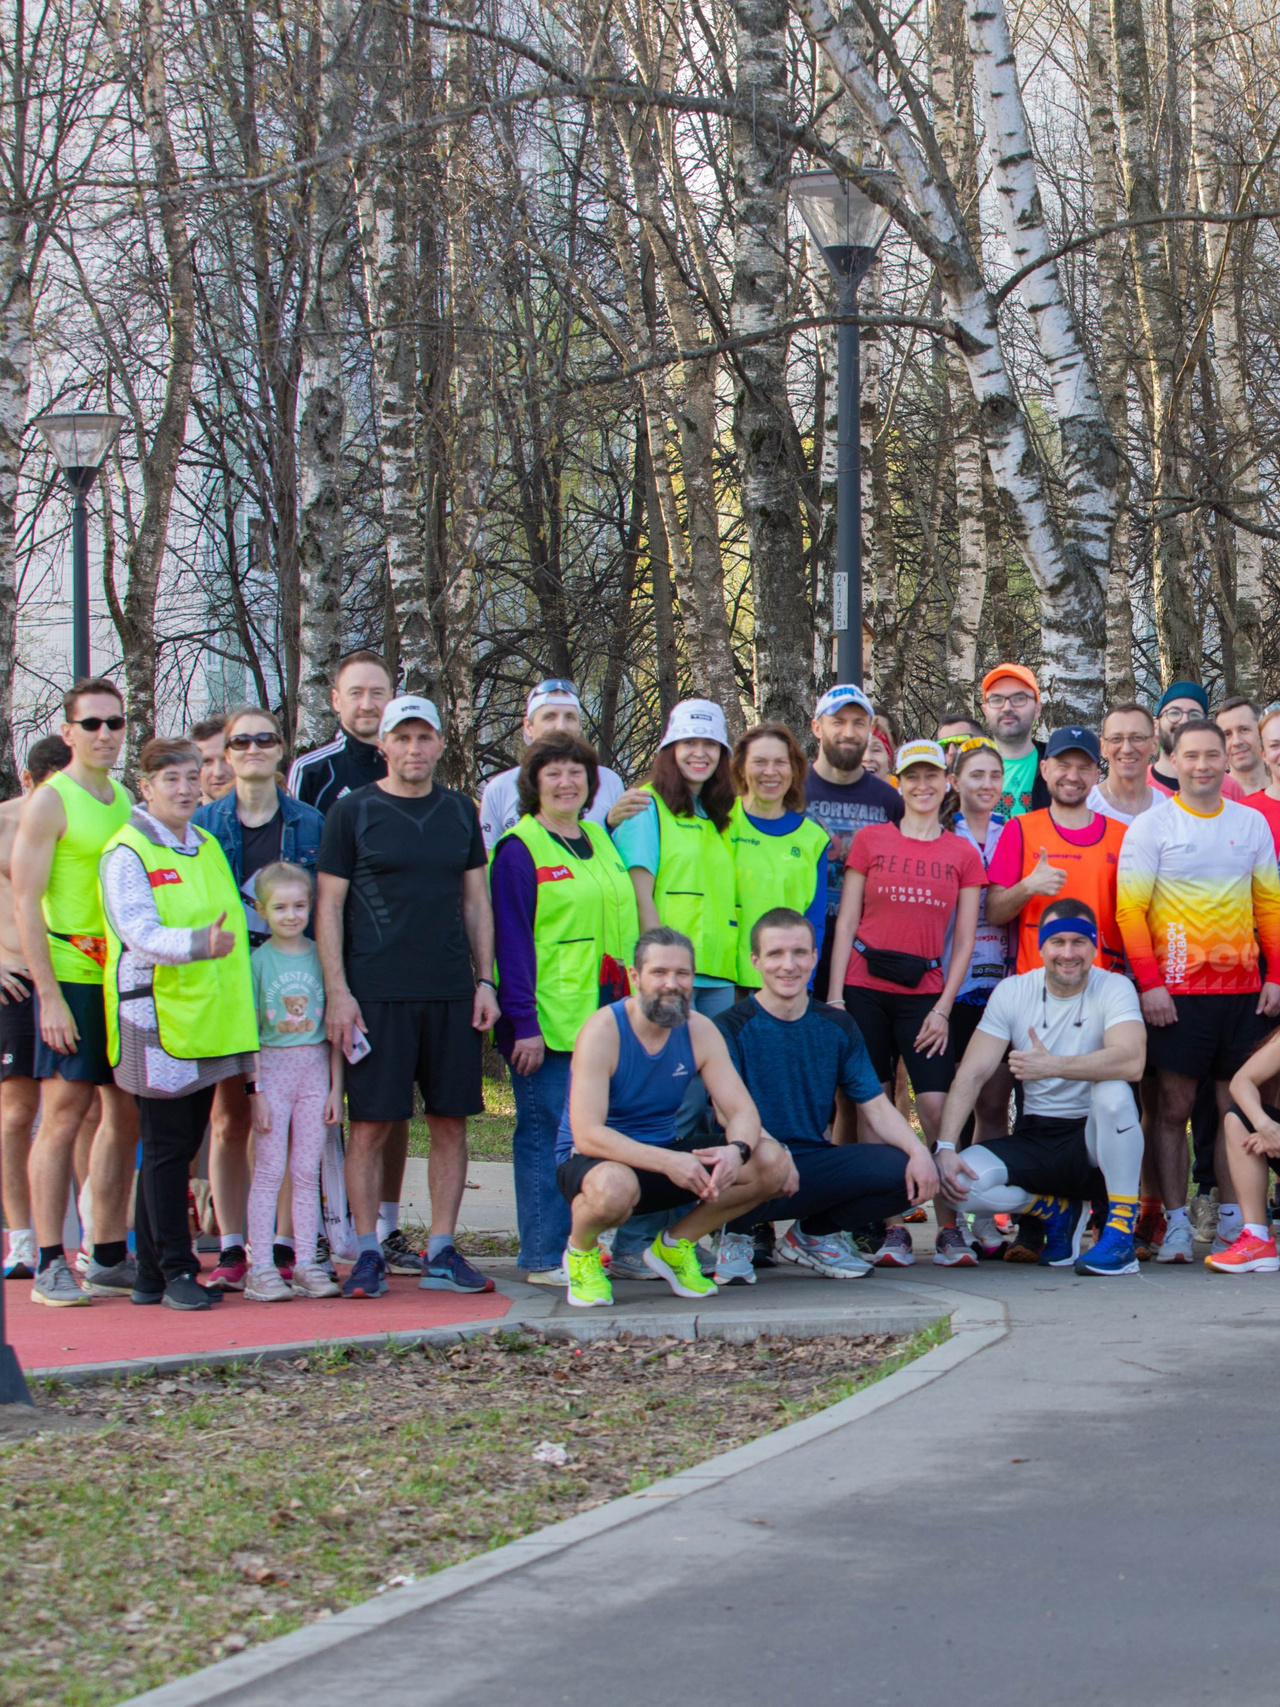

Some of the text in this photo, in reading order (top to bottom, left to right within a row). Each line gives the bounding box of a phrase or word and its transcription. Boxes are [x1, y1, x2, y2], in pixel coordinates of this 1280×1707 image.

[875, 855, 954, 882] REEBOK
[878, 886, 932, 896] FITNESS
[890, 895, 947, 908] COMPANY
[1165, 922, 1177, 983] МАРАФОН
[1175, 932, 1187, 983] МОСКВА
